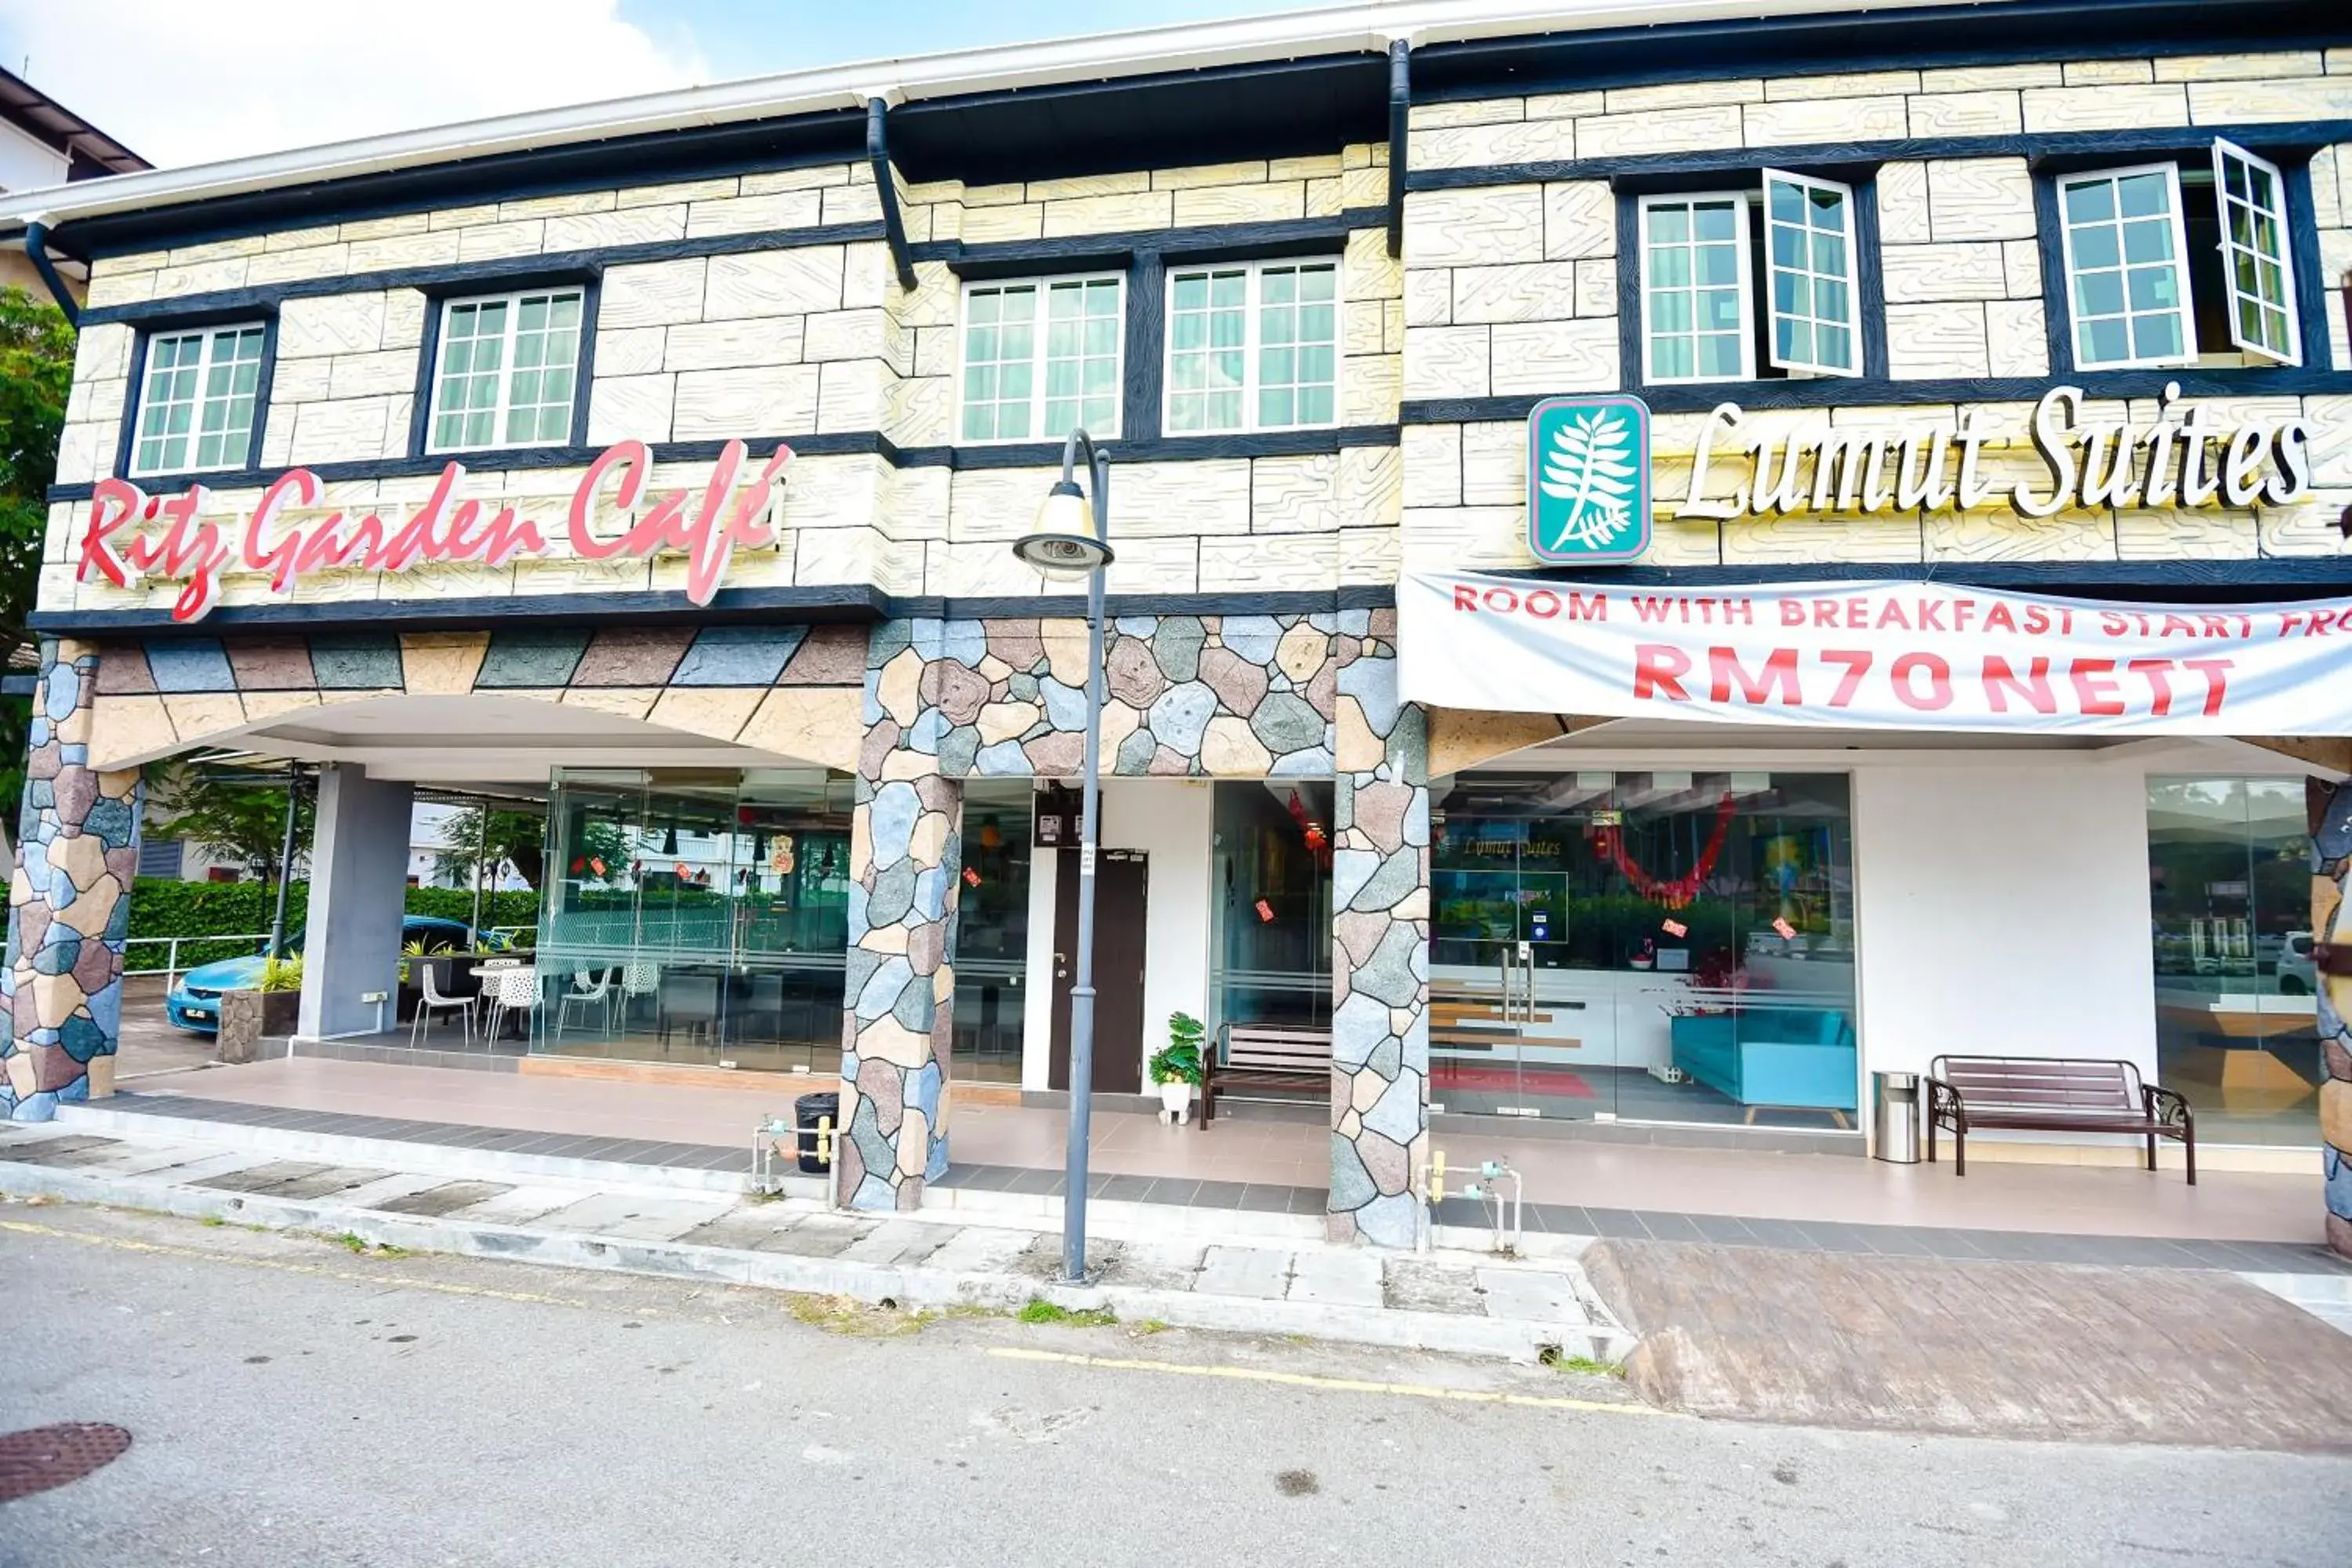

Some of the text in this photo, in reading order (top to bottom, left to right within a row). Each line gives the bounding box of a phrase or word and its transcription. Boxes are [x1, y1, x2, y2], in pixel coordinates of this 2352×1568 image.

[1675, 382, 2311, 518] Lumut Suites
[77, 440, 795, 622] Ritz Garden Café
[1454, 585, 1607, 622] ROOM
[1632, 596, 1753, 625] WITH
[1780, 598, 2074, 636] BREAKFAST
[2102, 609, 2252, 639] START
[1634, 644, 2235, 717] RM70 NETT
